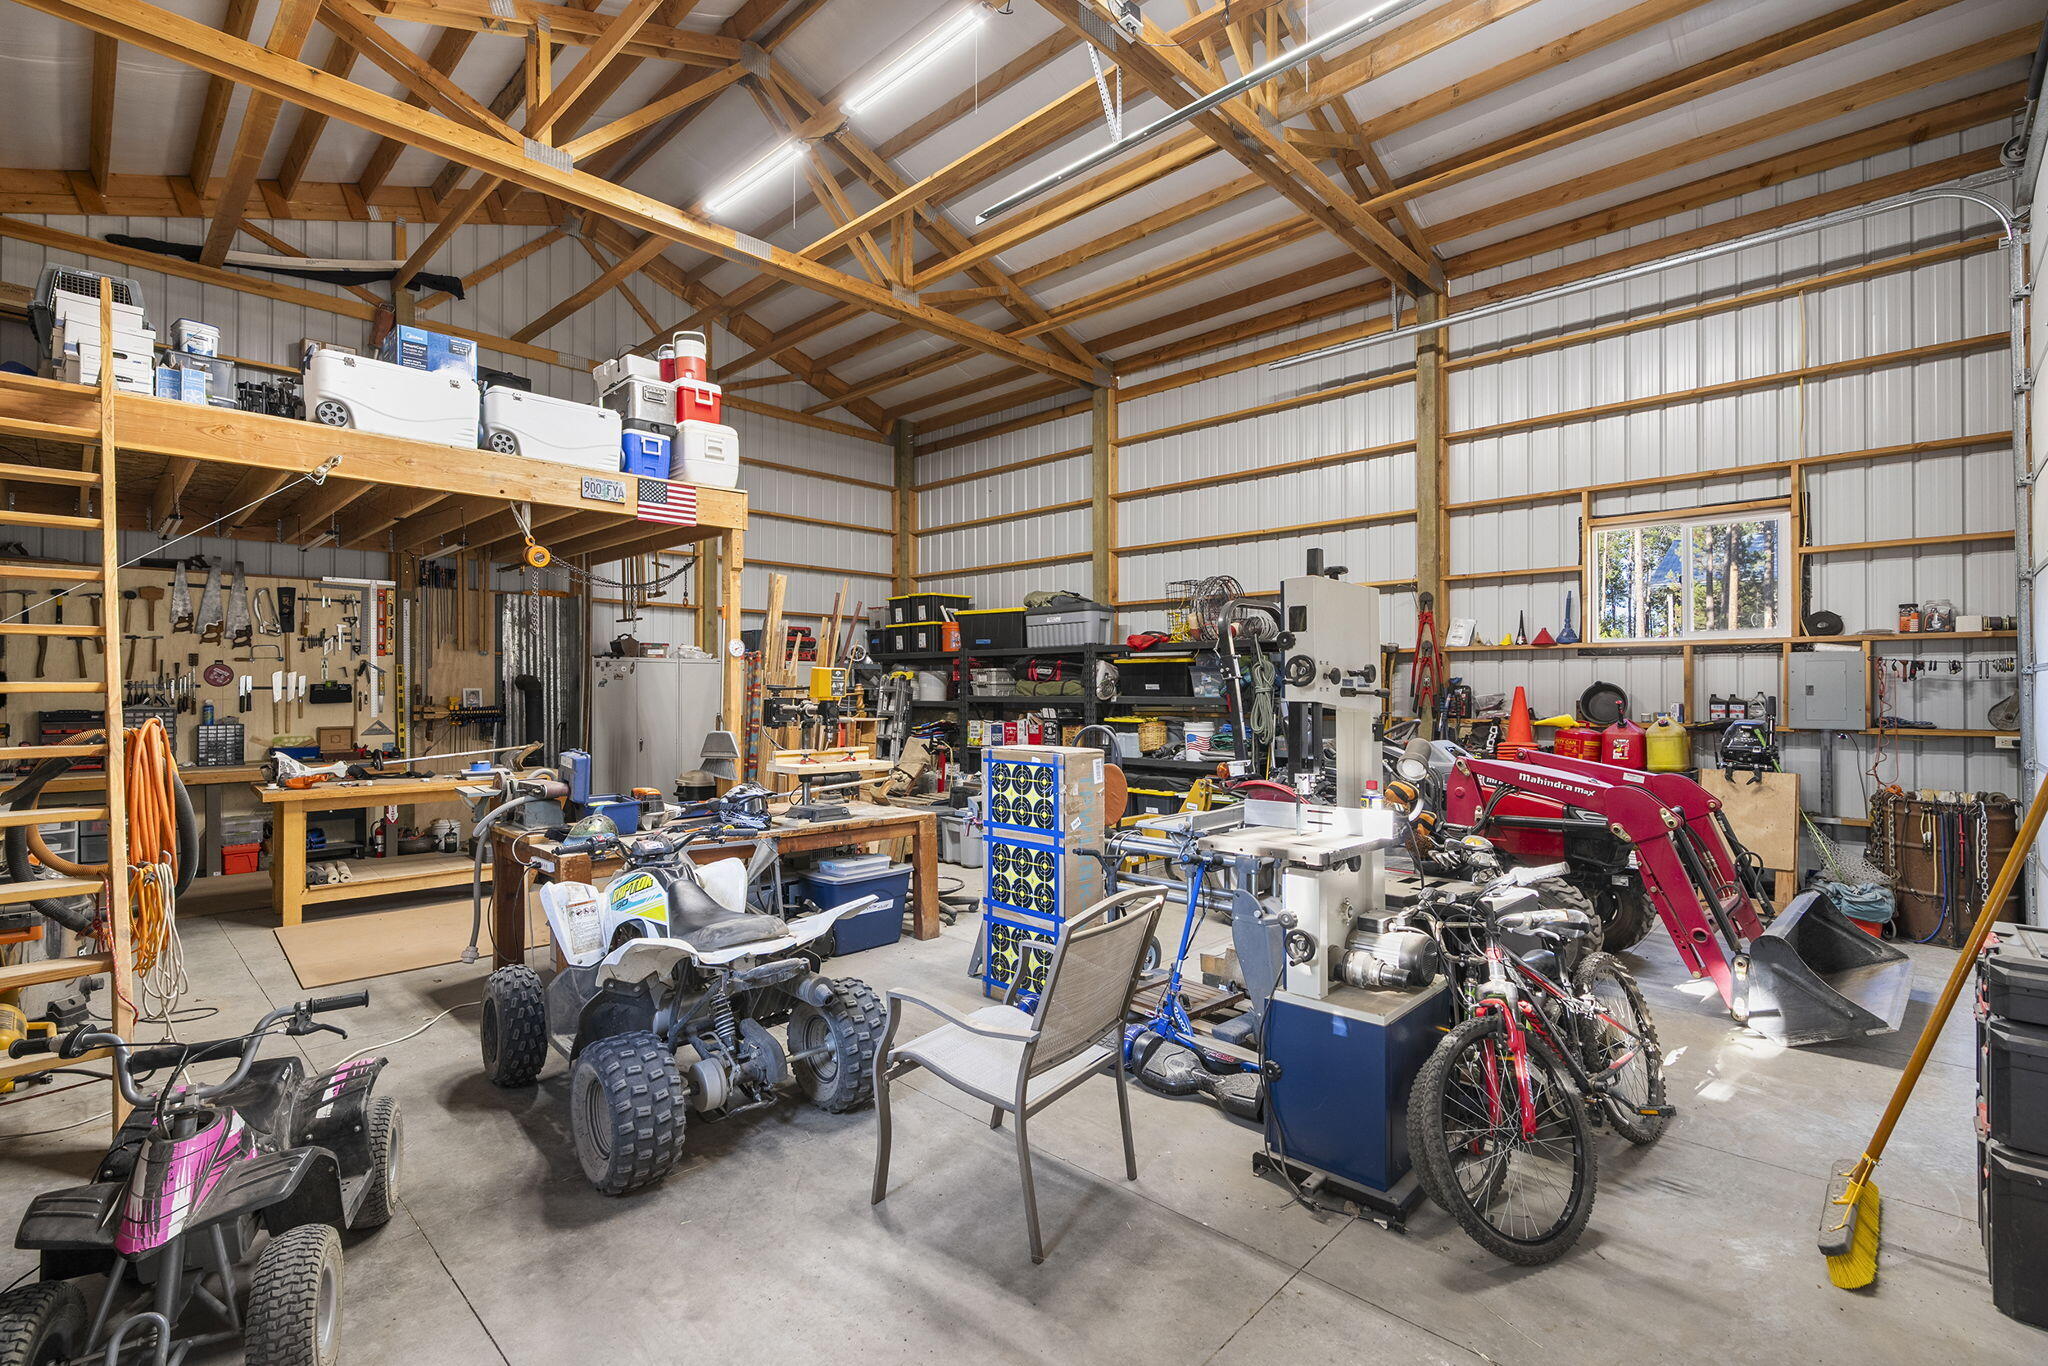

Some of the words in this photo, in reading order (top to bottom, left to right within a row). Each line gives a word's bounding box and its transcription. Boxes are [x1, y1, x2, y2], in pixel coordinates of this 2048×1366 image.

[584, 481, 602, 495] 900
[606, 484, 625, 499] FYA
[611, 875, 655, 906] RAPTOR
